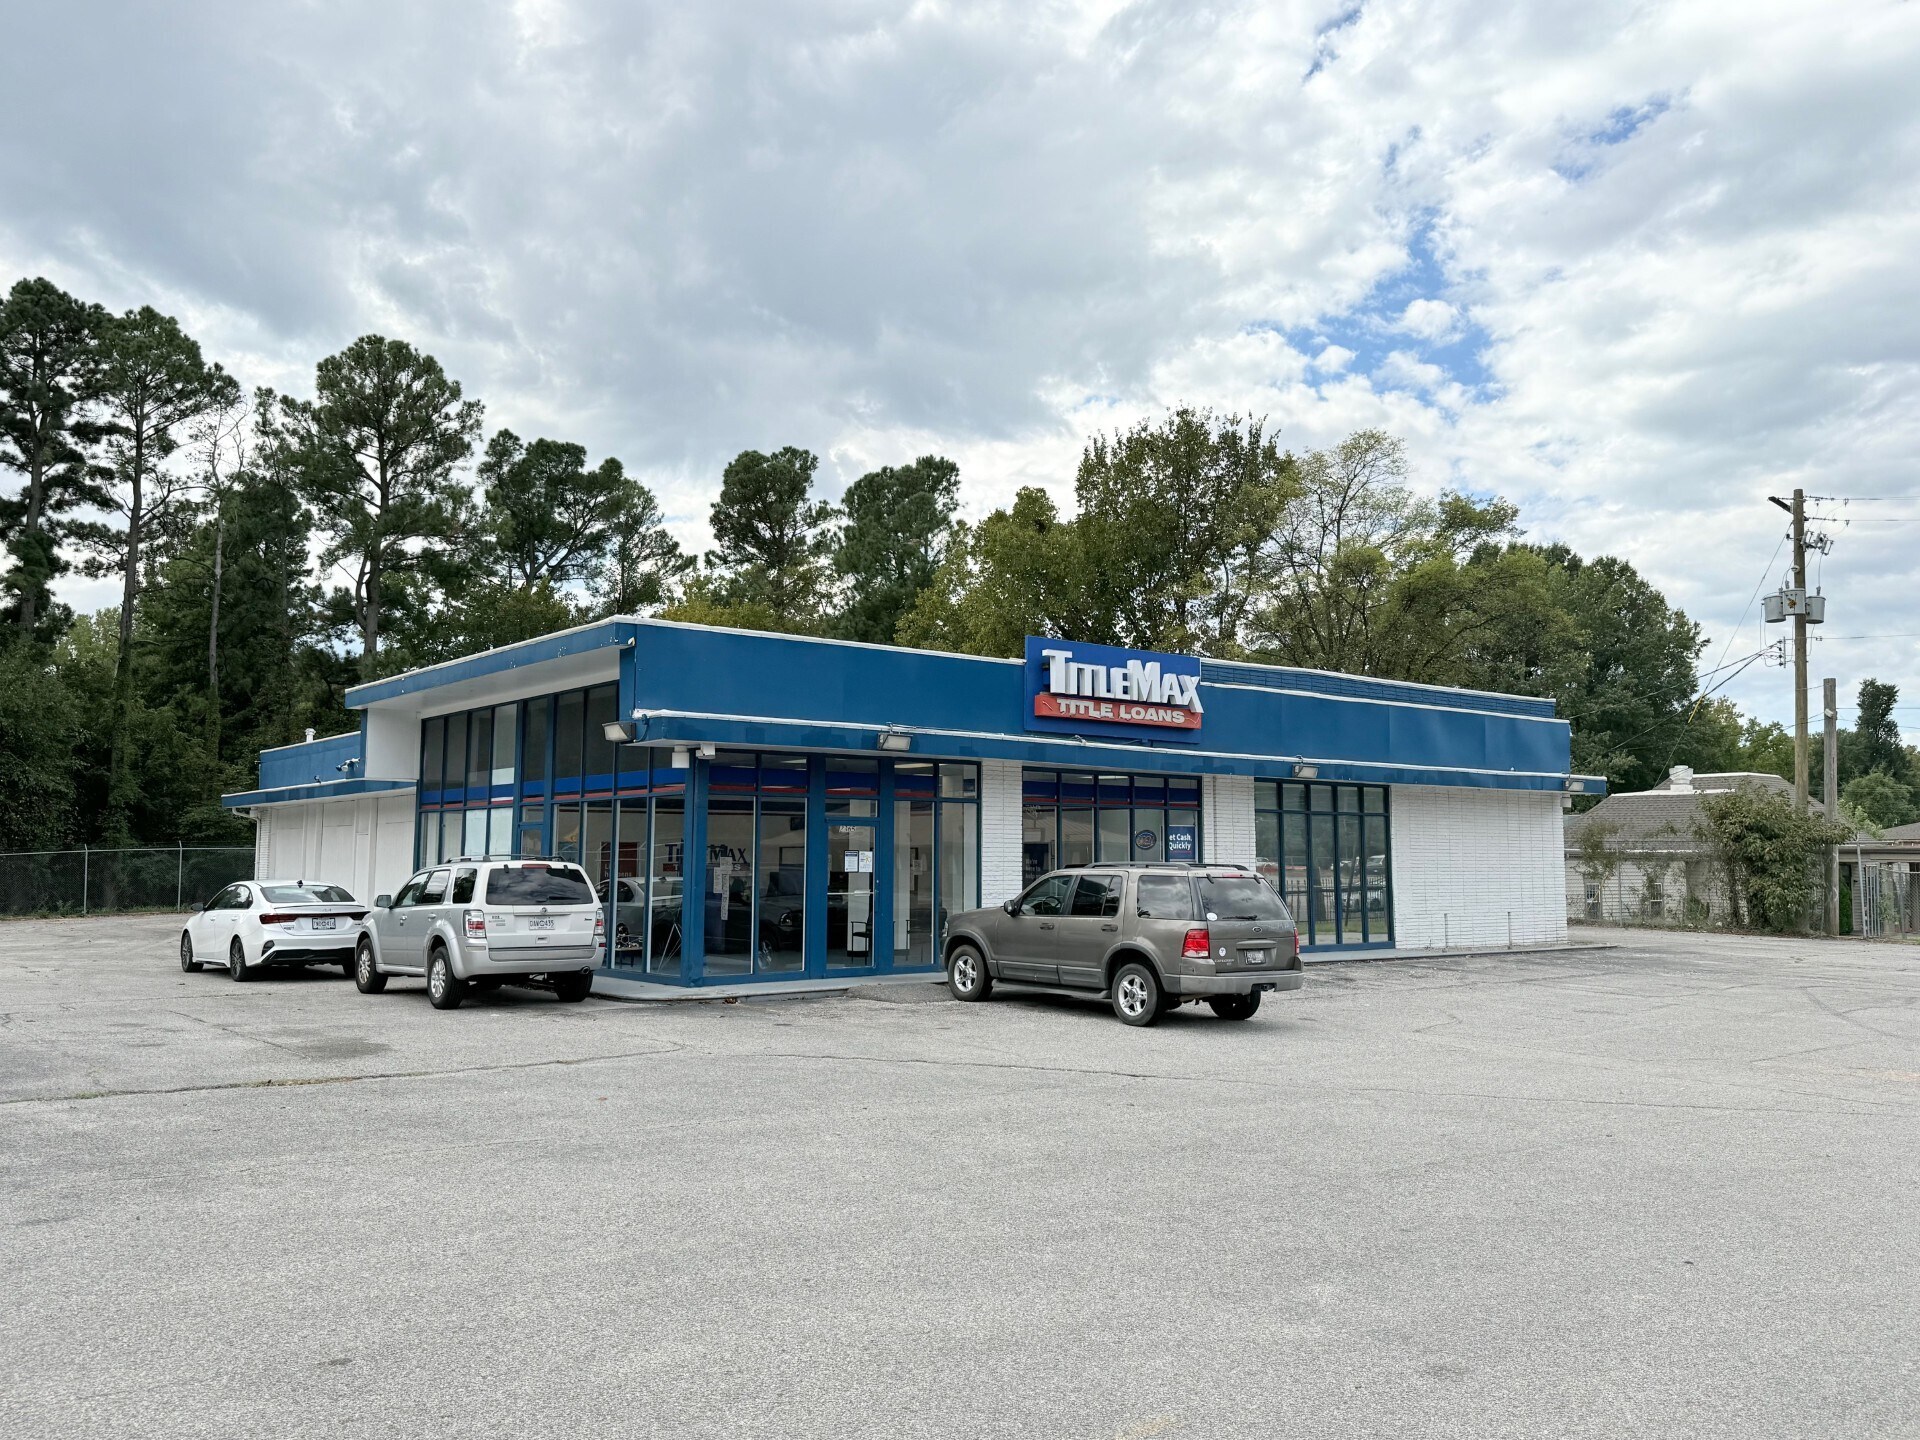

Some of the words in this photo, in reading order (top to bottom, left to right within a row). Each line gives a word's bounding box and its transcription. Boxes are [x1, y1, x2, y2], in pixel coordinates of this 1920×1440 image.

[1042, 649, 1204, 713] TITLEMAX
[1056, 698, 1114, 719] TITLE
[1118, 704, 1185, 724] LOANS
[1169, 842, 1192, 851] Quickly
